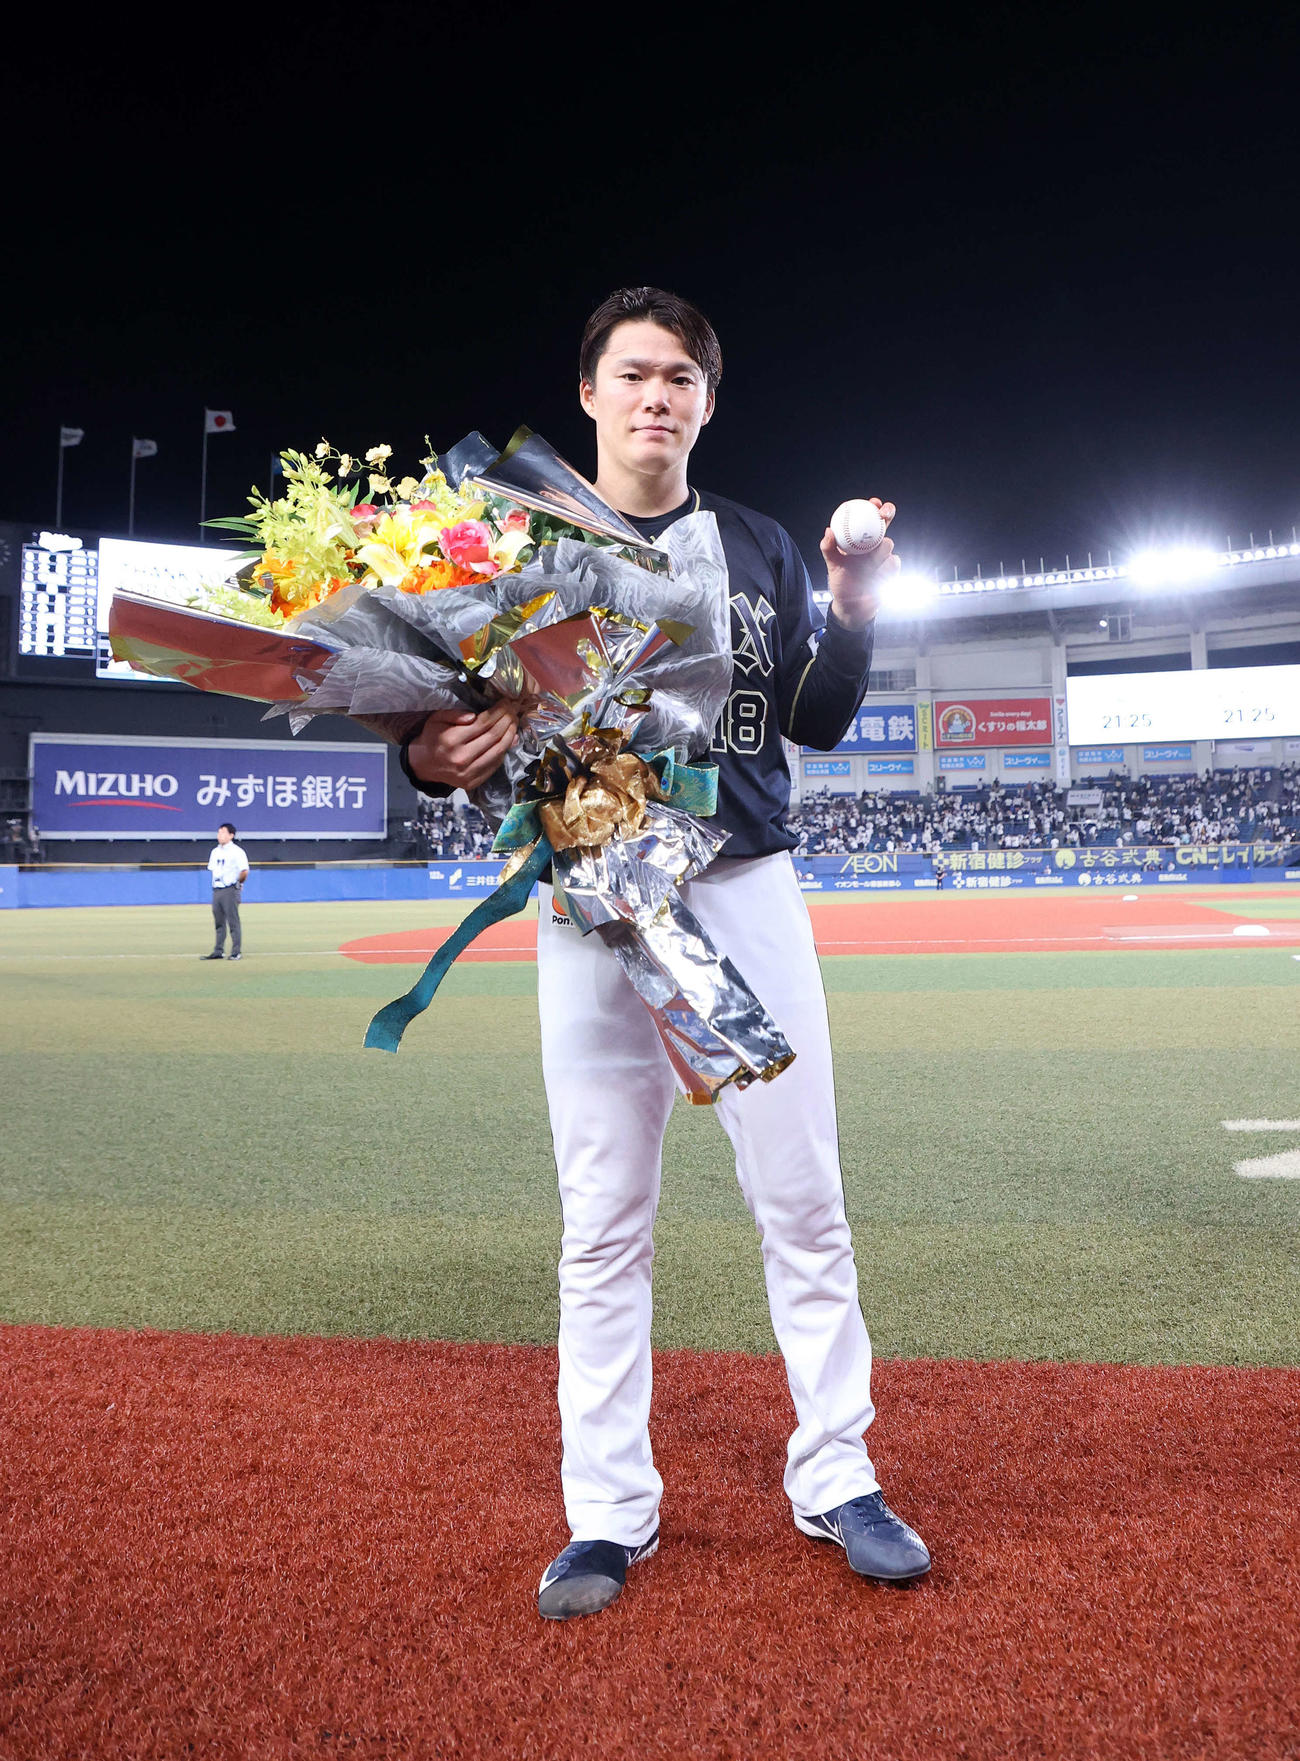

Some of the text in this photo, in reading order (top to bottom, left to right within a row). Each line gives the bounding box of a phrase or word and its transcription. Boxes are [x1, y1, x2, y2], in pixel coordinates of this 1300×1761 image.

[710, 690, 768, 754] 18
[54, 769, 179, 797] MIZUHO
[196, 774, 368, 809] みずほ銀行
[1079, 848, 1163, 867] 古谷式典
[1092, 874, 1143, 886] 古谷式典
